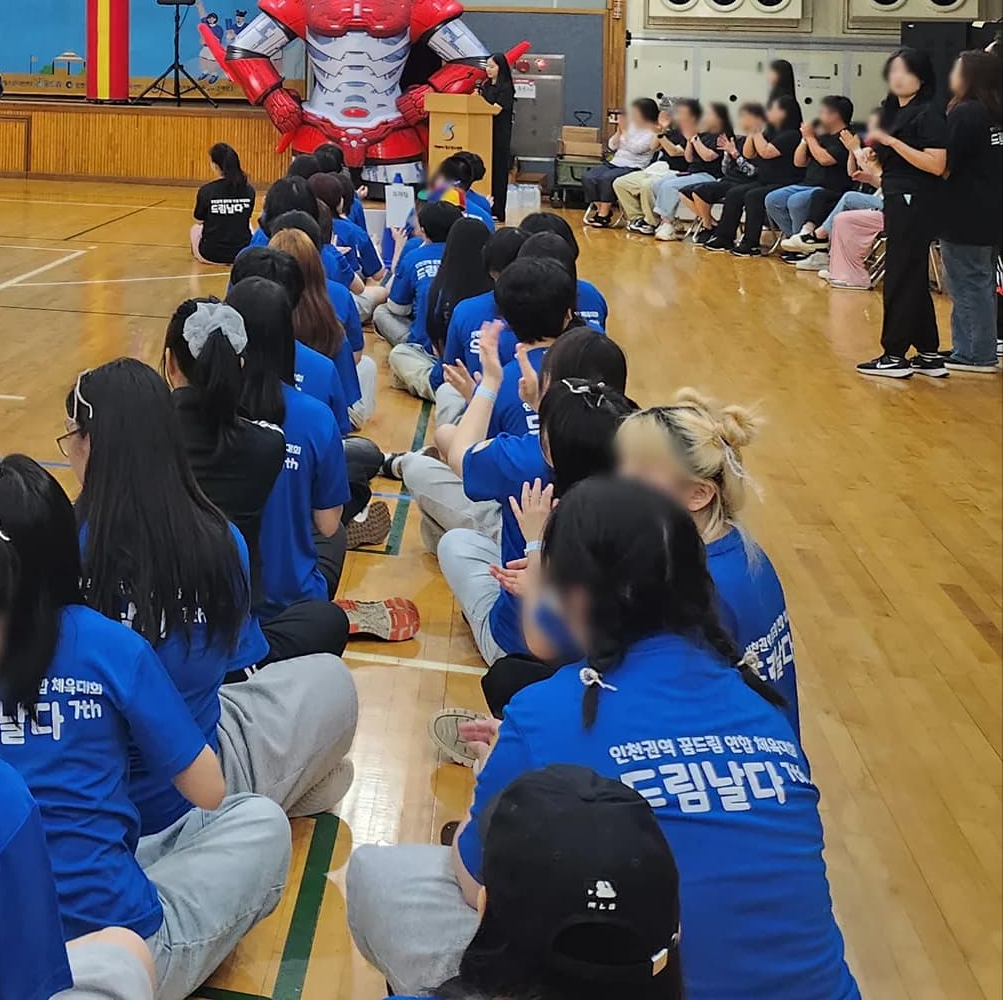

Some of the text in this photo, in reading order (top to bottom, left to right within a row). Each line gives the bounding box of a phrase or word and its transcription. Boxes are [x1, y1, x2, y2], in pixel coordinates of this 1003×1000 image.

[284, 456, 299, 471] th
[51, 677, 103, 696] 체육대회
[67, 699, 102, 720] 7th
[608, 737, 677, 765] 인천권역
[677, 735, 724, 756] 꿈드림
[724, 734, 754, 755] 연합
[619, 760, 786, 814] 드림날다
